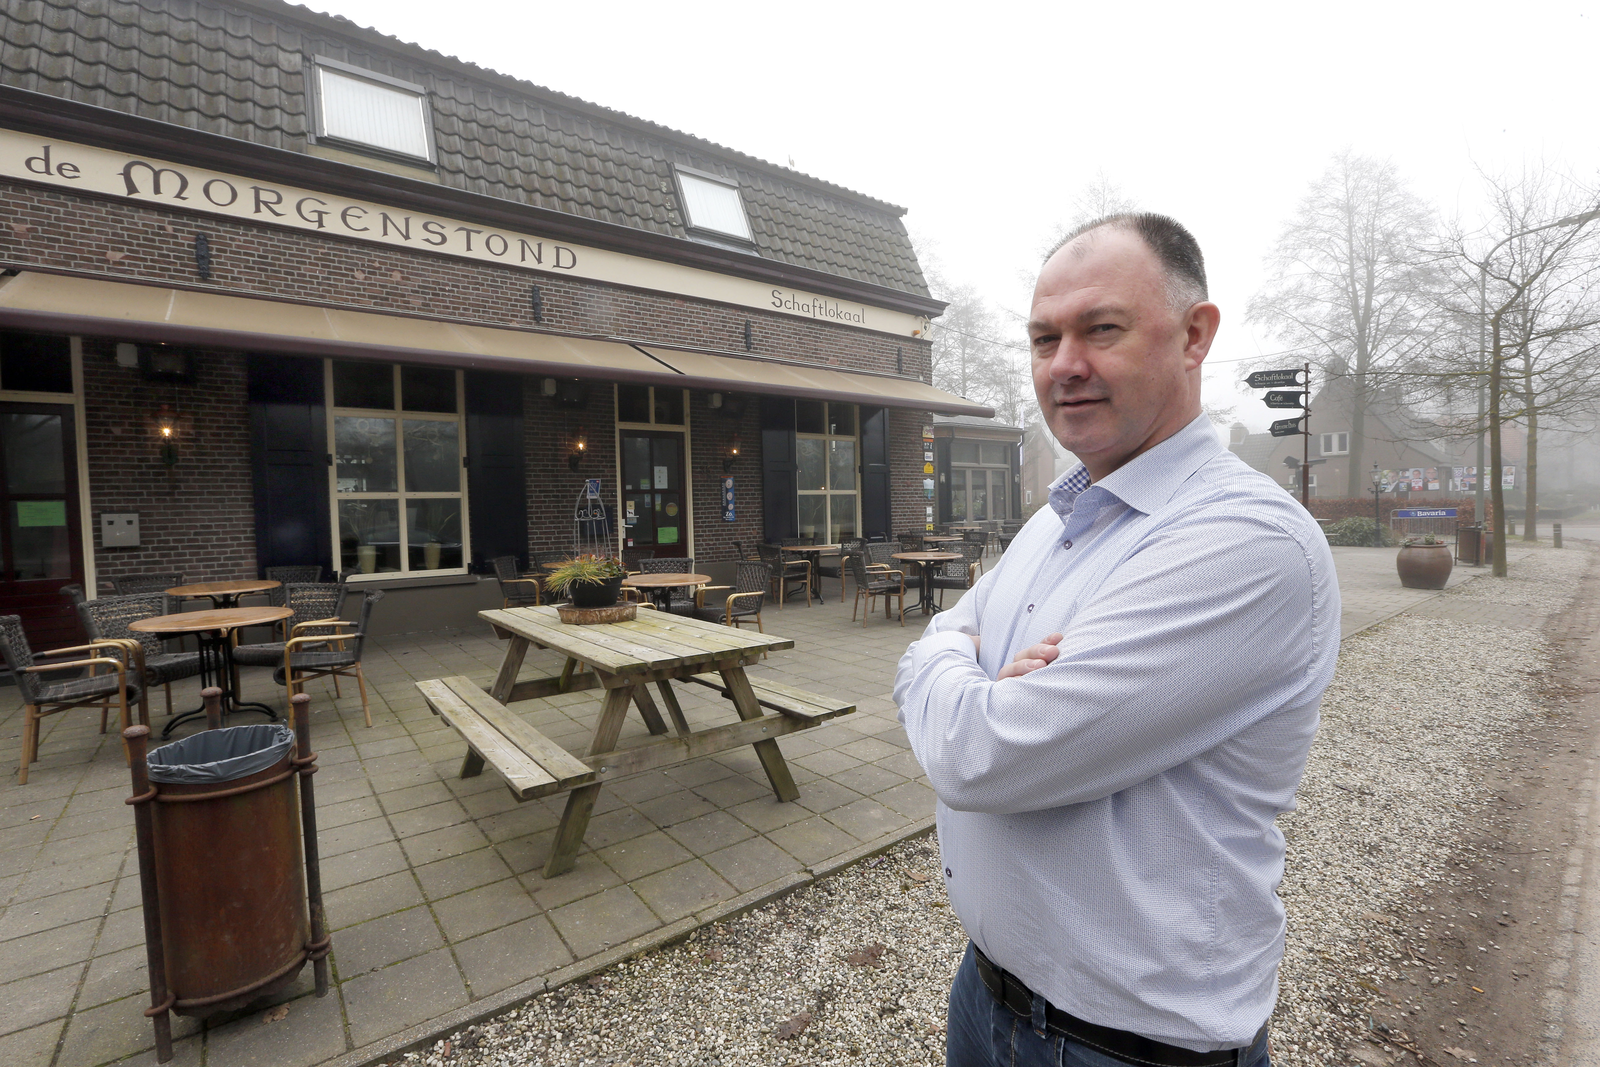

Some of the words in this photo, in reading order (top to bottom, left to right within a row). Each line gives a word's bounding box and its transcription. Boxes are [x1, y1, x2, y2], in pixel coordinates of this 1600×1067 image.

[24, 145, 81, 180] de
[116, 160, 577, 270] MORGENSTOND
[771, 289, 866, 324] Schaftlokaal
